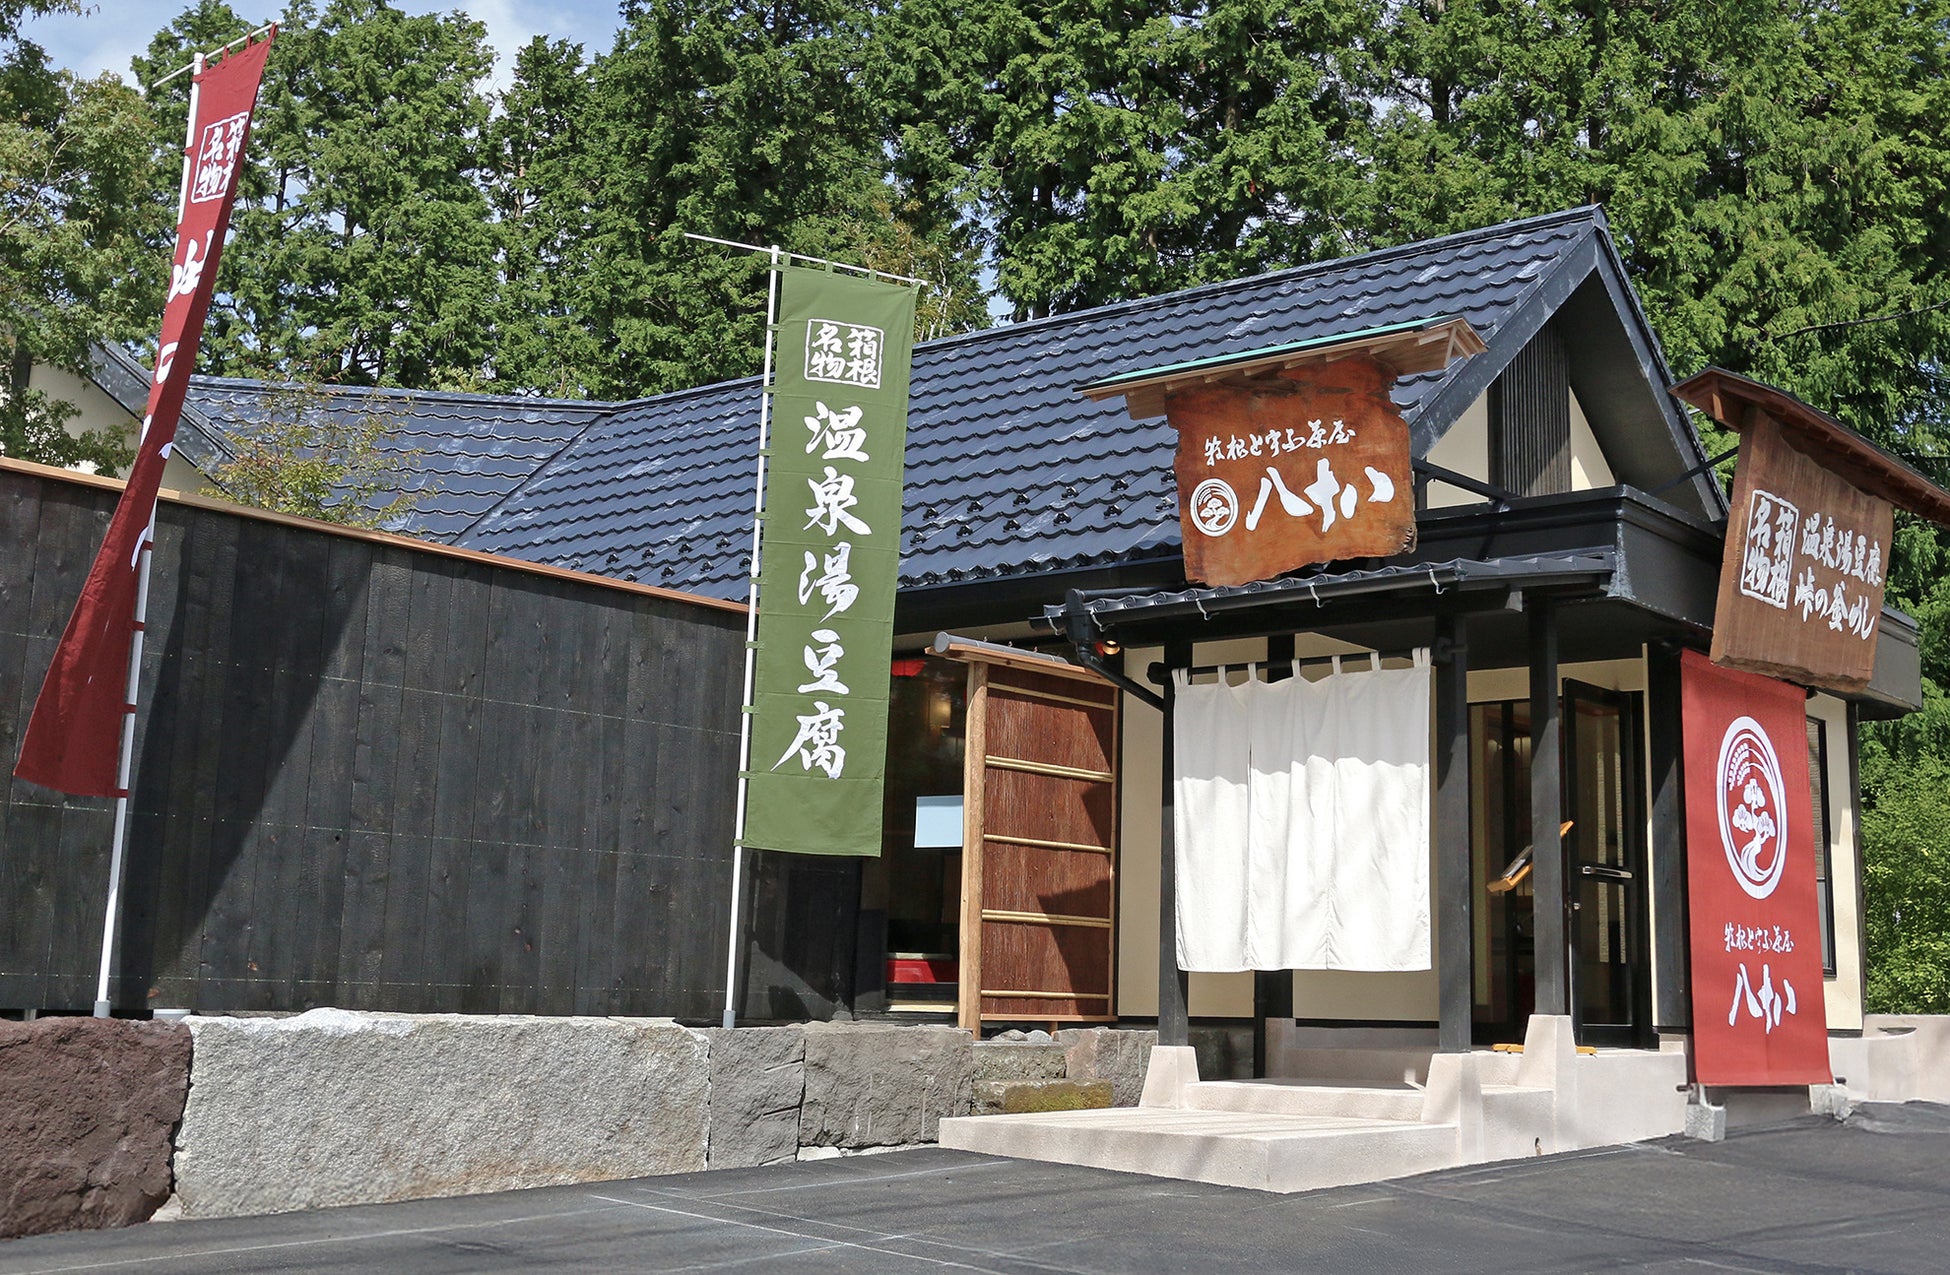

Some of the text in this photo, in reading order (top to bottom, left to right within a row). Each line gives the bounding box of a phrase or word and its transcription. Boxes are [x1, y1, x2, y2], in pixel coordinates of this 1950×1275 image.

[809, 322, 846, 379] 名物
[845, 328, 878, 384] 箱根
[1745, 497, 1772, 595] 名物
[1767, 506, 1794, 603] 箱根
[1801, 512, 1882, 587] 温泉湯豆腐
[768, 401, 872, 780] 温泉湯豆腐
[1794, 566, 1876, 641] 峠の釜めし
